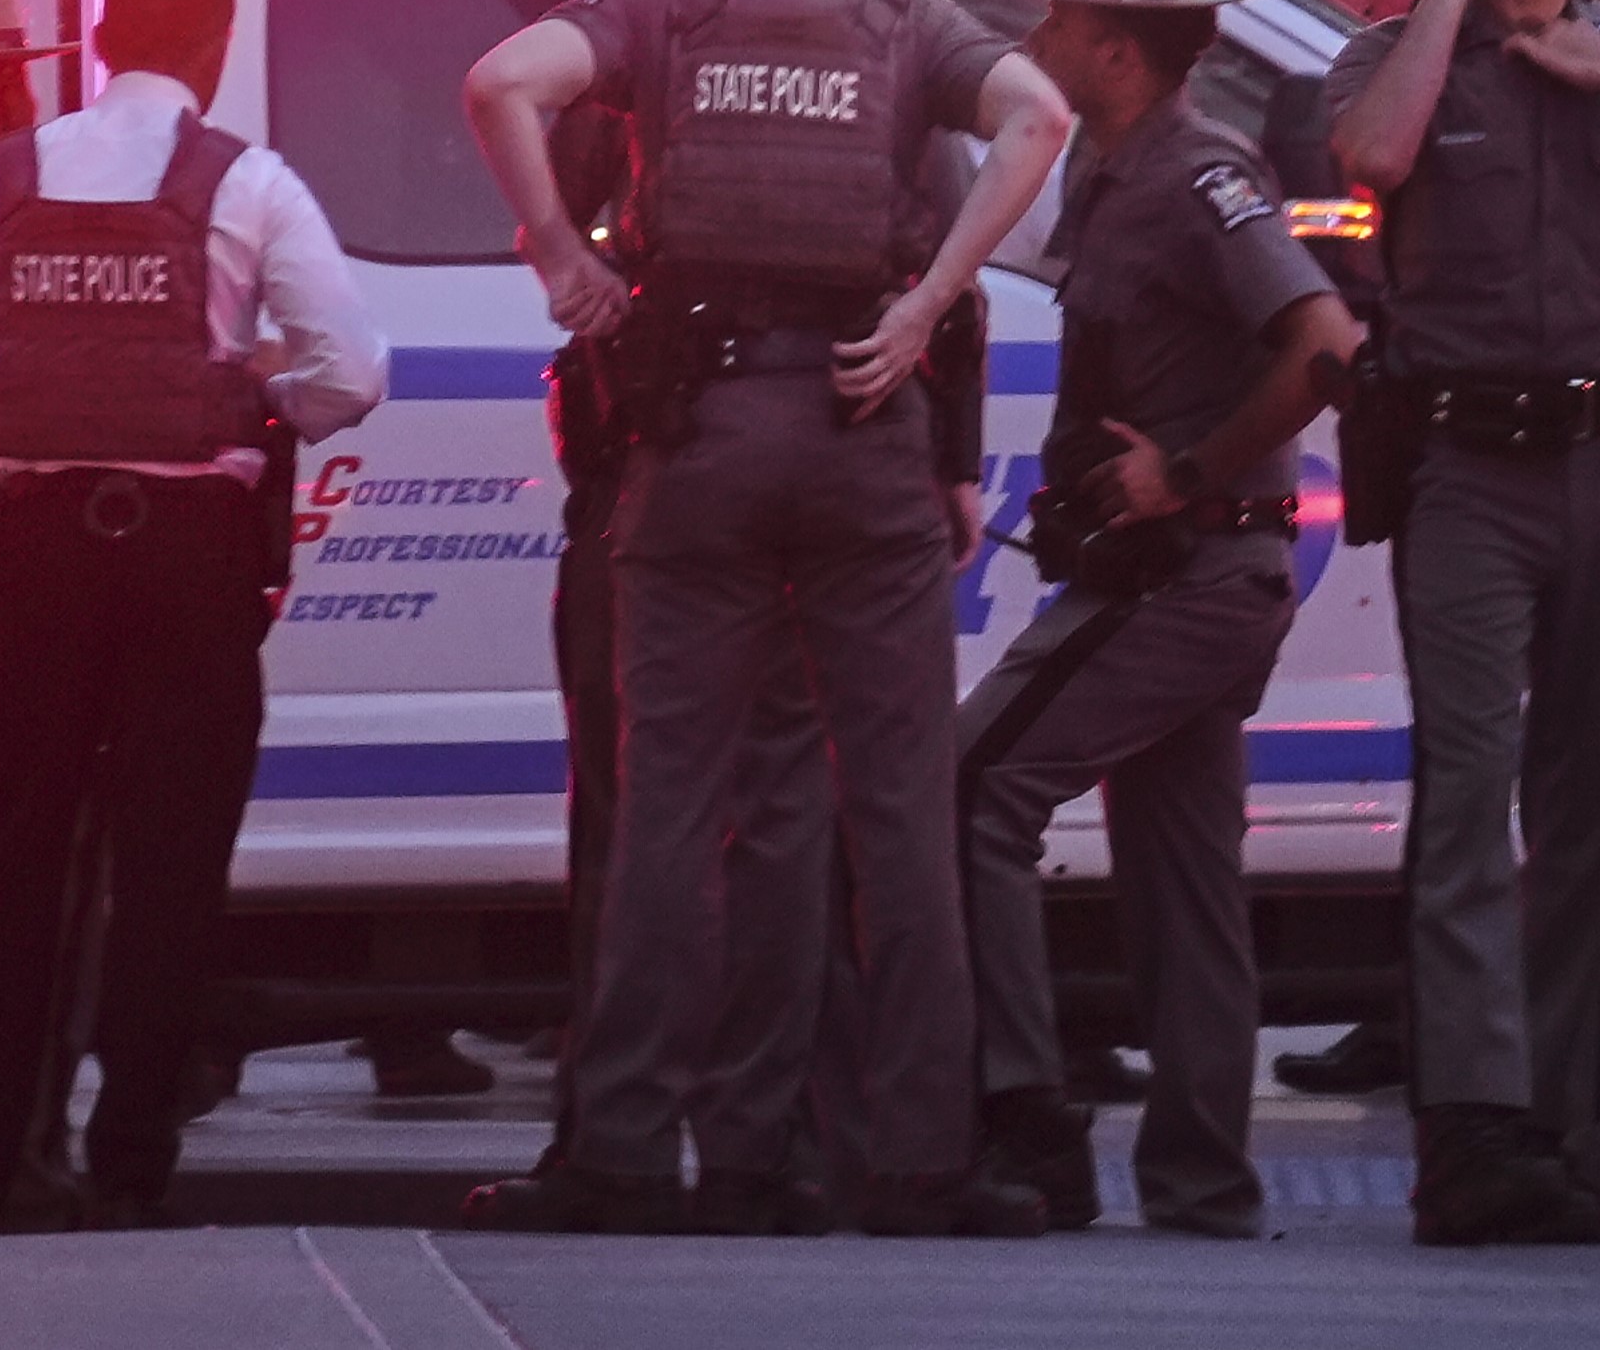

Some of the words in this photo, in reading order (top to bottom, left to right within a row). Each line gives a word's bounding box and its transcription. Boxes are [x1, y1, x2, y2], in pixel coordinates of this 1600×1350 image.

[693, 62, 769, 114] STATE
[771, 65, 862, 123] POLICE
[11, 254, 81, 303] STATE
[84, 254, 170, 303] POLICE
[308, 455, 528, 507] COURTESY
[270, 588, 438, 622] ESPECT
